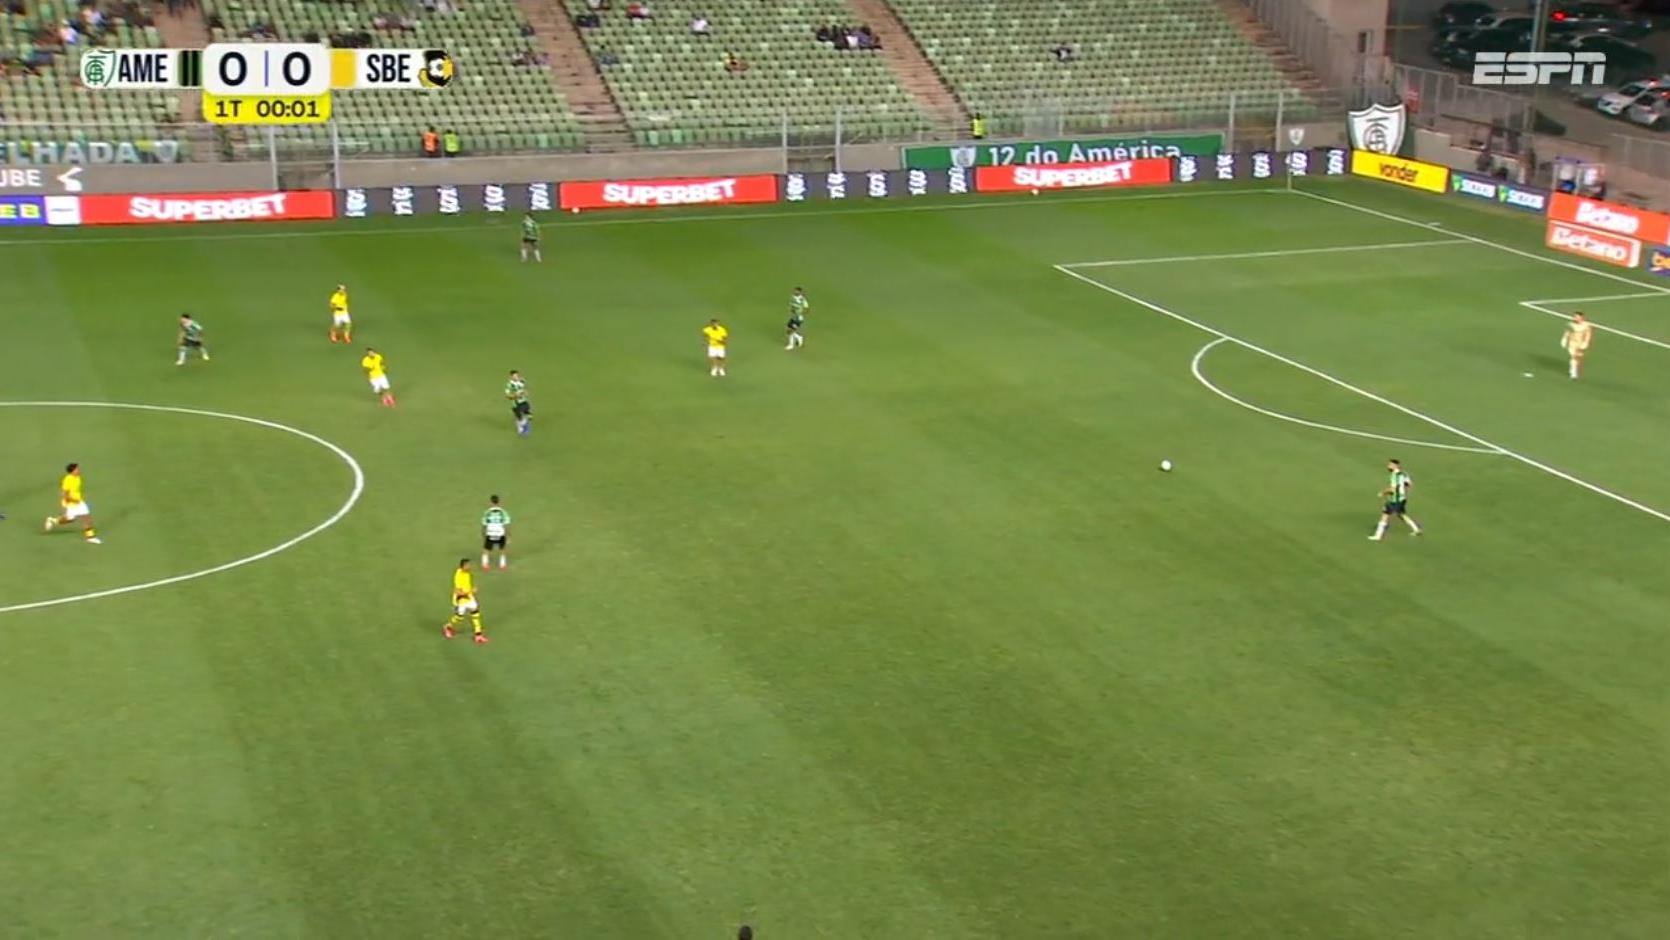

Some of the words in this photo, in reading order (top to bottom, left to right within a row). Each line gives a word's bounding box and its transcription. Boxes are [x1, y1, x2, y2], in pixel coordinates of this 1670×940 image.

[0, 140, 140, 164] LHADA
[990, 146, 1015, 165] 12
[1026, 145, 1058, 165] do
[1068, 140, 1180, 163] América
[1013, 161, 1133, 187] SUPERBET
[603, 178, 736, 204] SUPERBET
[129, 194, 286, 220] SUPERBET
